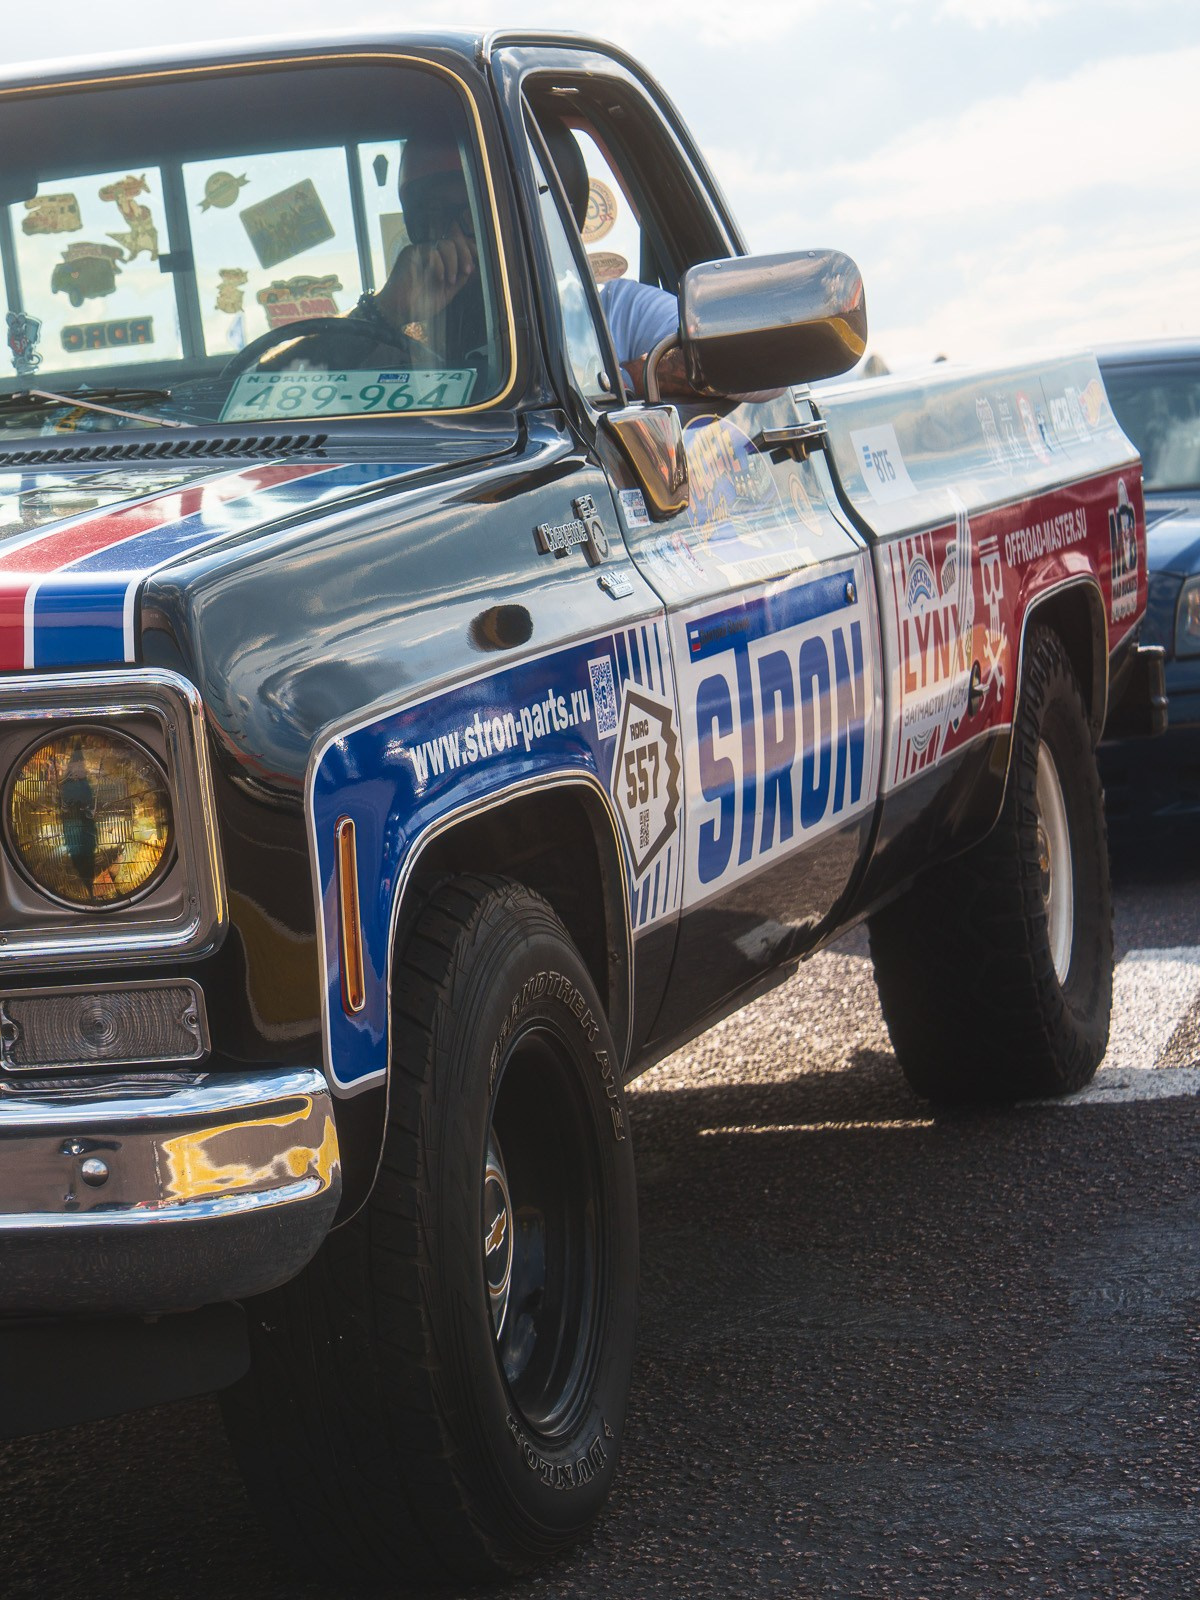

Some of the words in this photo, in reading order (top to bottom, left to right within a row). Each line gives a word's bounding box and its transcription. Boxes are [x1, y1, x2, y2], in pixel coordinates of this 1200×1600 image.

[244, 383, 449, 412] 489-964
[872, 448, 896, 484] ВТБ
[1004, 507, 1088, 569] OFFROAD-MASTER.SU
[903, 603, 966, 694] LYNX
[408, 687, 591, 783] www.stron-parts.ru
[686, 569, 865, 885] STRON
[624, 741, 660, 810] 557
[506, 1413, 608, 1490] DUNLOP
